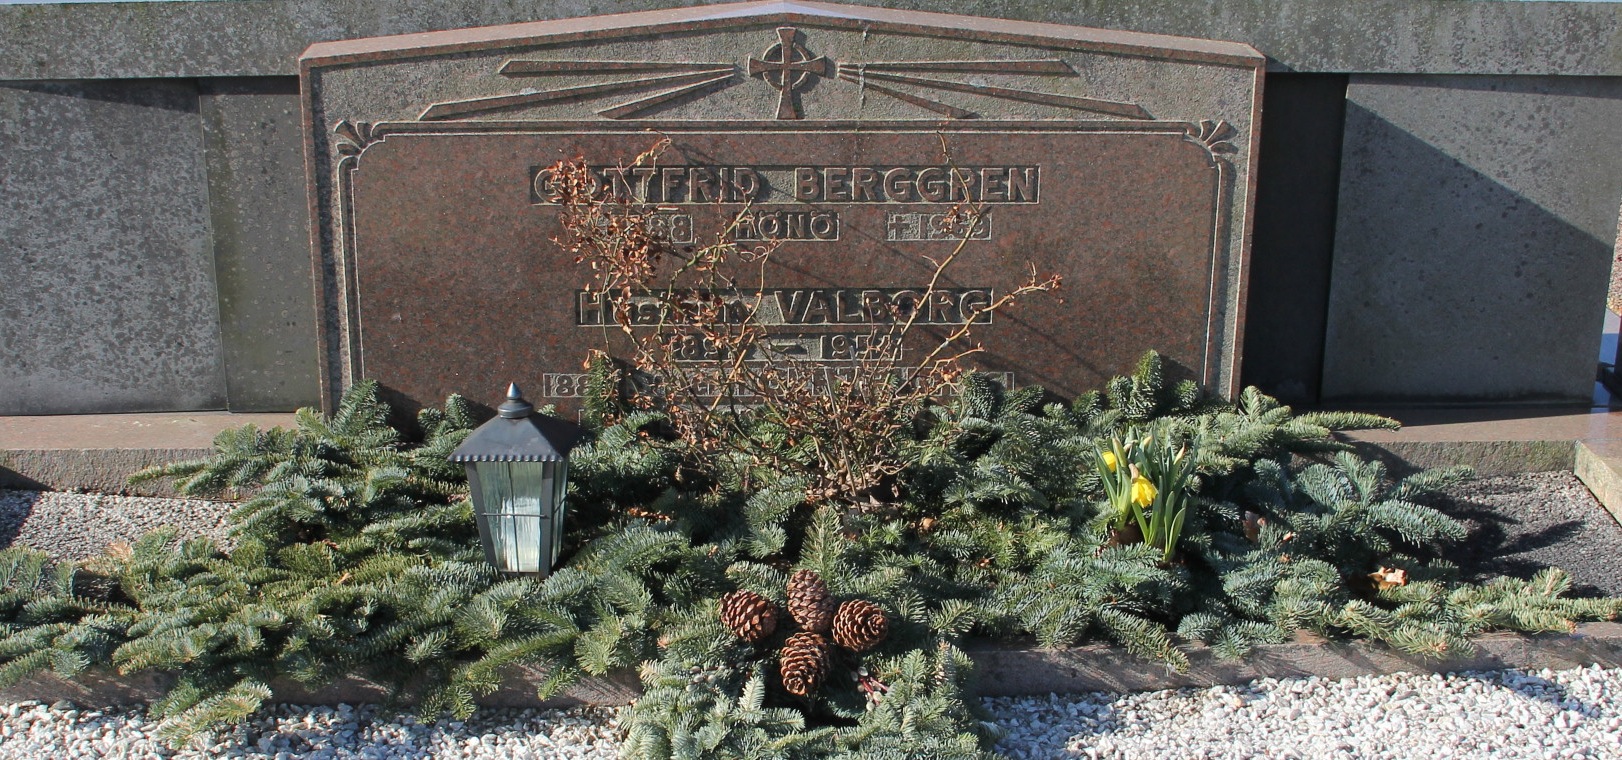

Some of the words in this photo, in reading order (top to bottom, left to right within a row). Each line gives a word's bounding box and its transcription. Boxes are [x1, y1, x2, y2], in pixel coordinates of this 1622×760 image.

[533, 166, 761, 203] GOTTFRID
[793, 166, 1036, 203] BERGGREN
[773, 289, 991, 324] VALBORG
